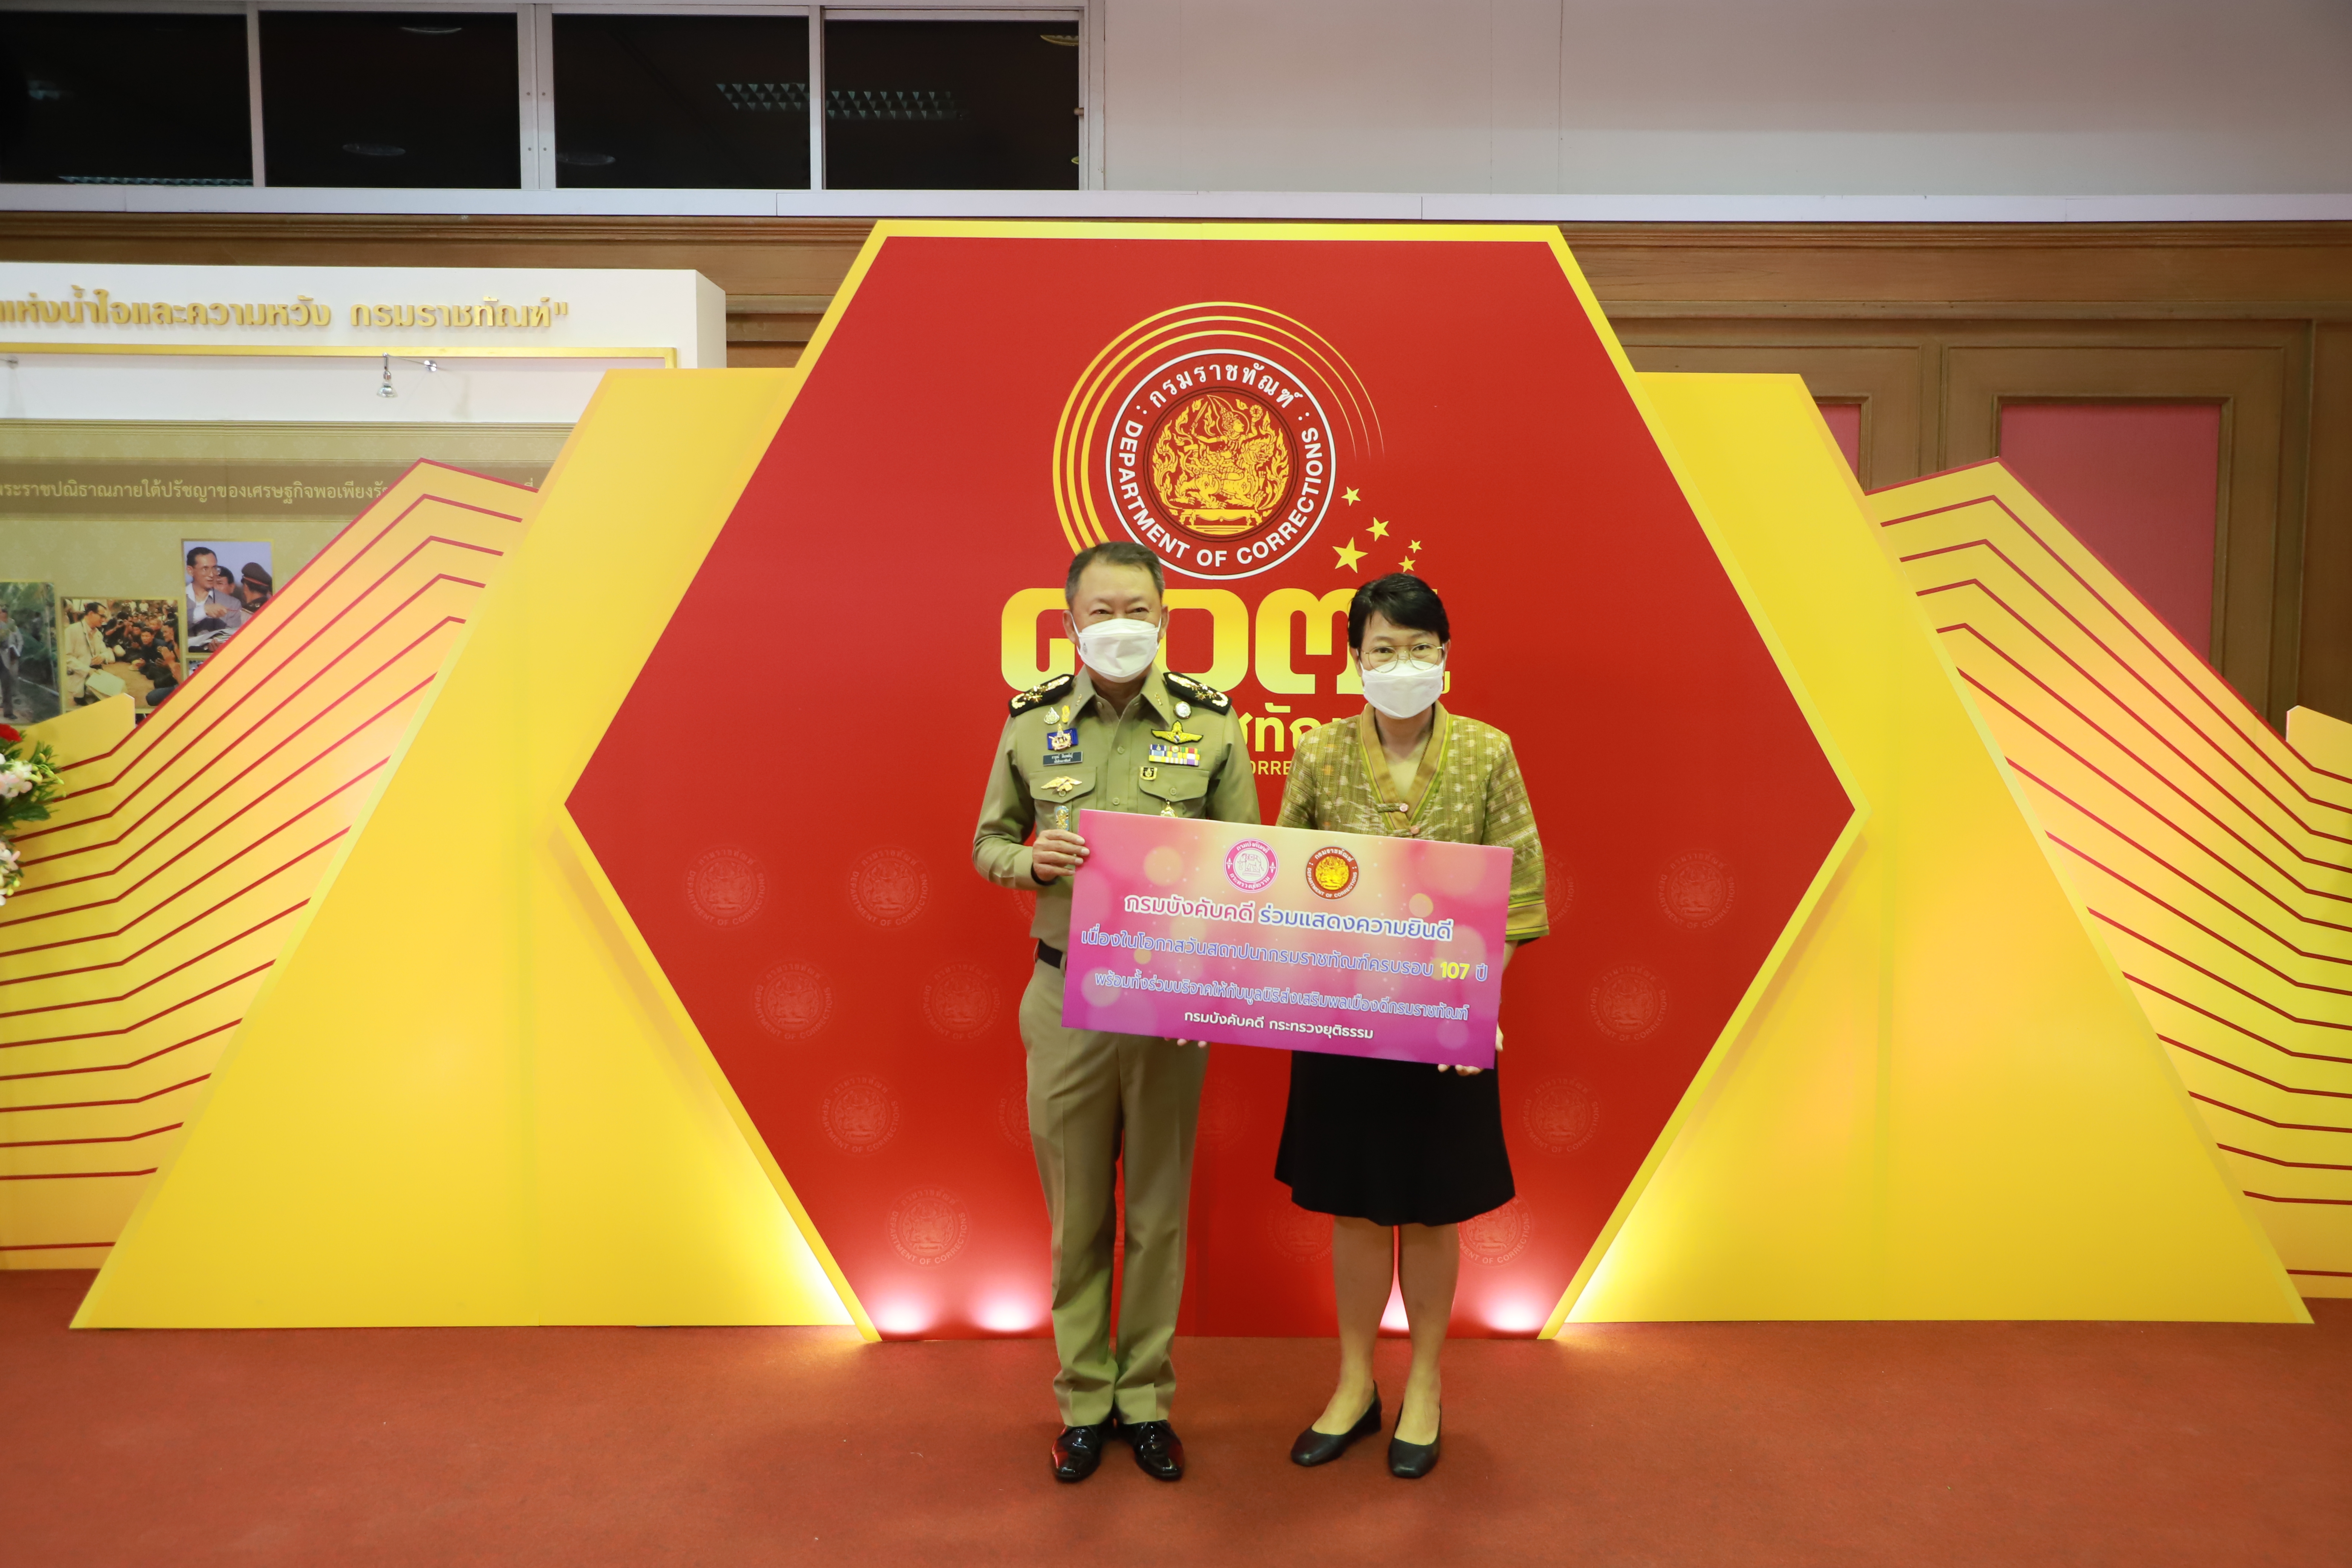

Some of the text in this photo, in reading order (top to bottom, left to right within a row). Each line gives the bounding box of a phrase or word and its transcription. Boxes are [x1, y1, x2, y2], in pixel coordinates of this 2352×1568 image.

[1150, 363, 1303, 408] กรมราชทัณฑ์
[1119, 420, 1323, 567] DEPARTMENT OF CORRECTIONS
[1307, 868, 1325, 896] DEPARTMENT
[1334, 872, 1358, 898] CORRECTIONS
[1125, 895, 1453, 940] กรมบังคับคดี ร่วมแสดงความยินดี
[1081, 924, 1488, 982] เนื่องในโอกาสวันสถาปนากรมราชทัณฑ์ครบรอบ 107 ปี
[1095, 969, 1469, 1021] พร้อมทั้งร่วมบริจาคให้กับมูลนิธิส่งเสริมพลเมืองดีกรมราชทัณฑ์
[1184, 1011, 1374, 1039] กรมบังคับคดี กระทรวงยุติธรรม
